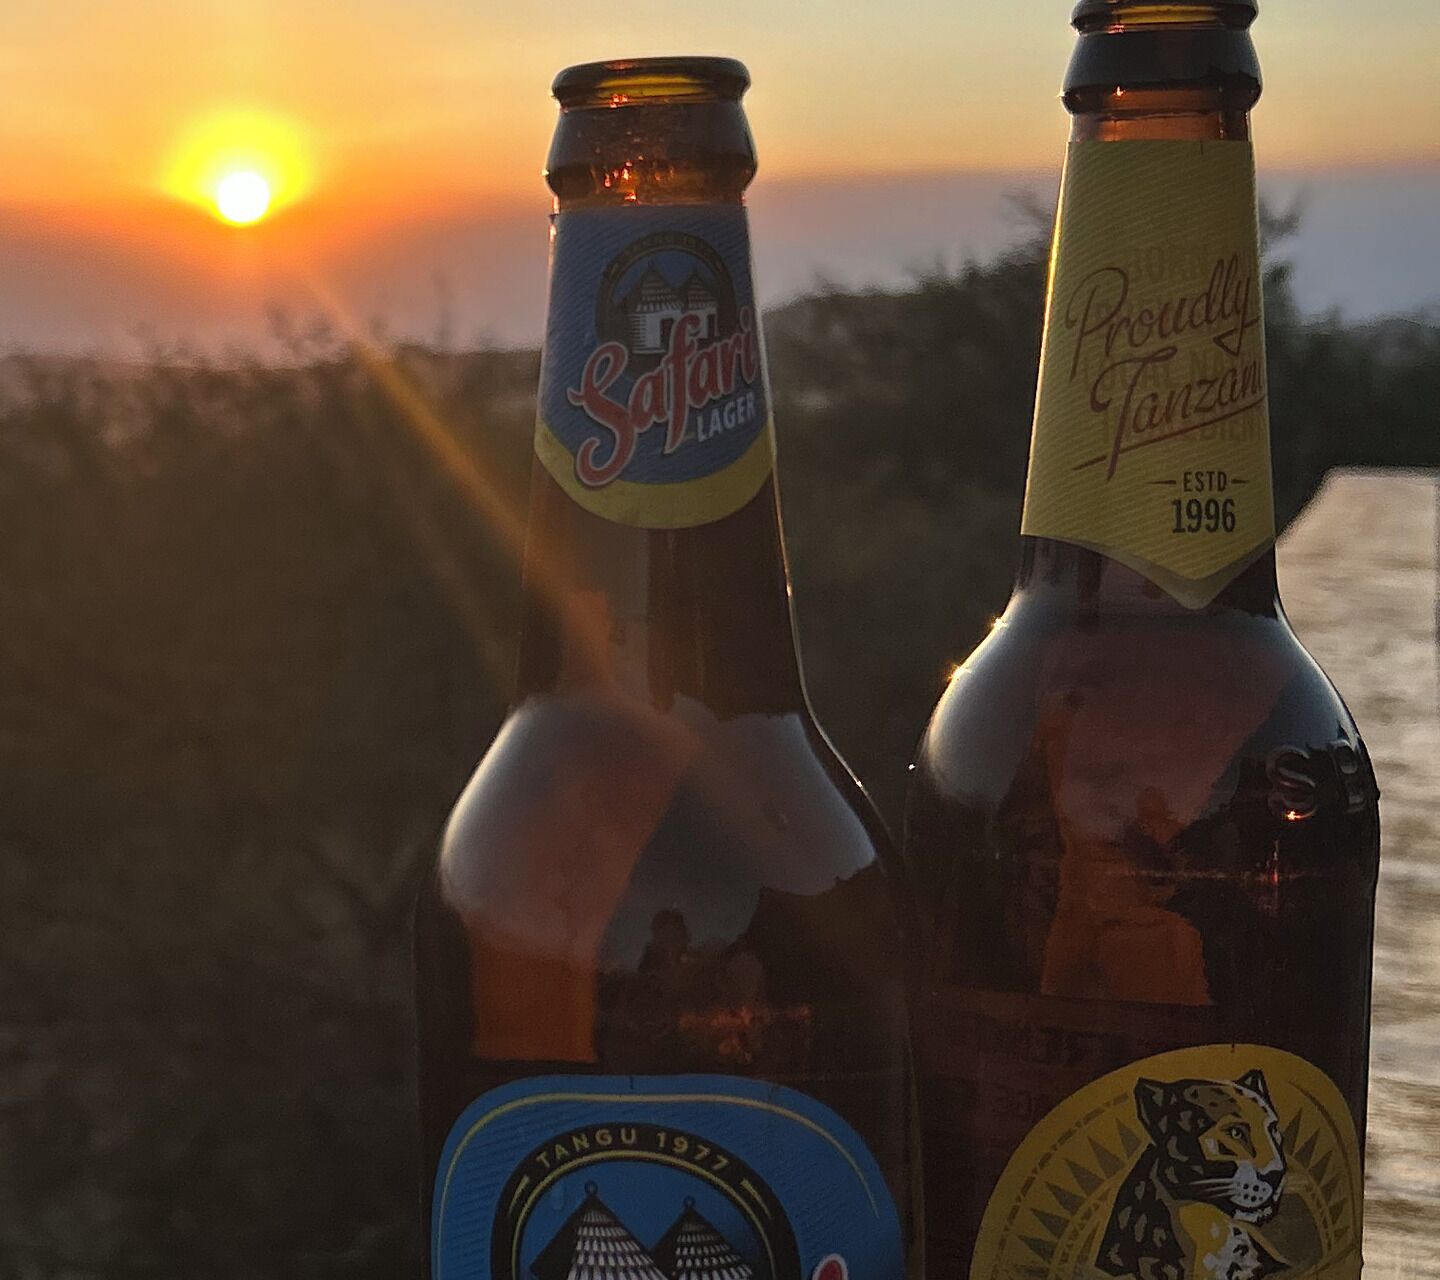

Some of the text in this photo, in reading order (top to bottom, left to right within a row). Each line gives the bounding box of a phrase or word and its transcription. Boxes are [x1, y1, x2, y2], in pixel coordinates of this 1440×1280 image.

[1065, 252, 1259, 382] Proudly
[567, 306, 756, 487] Safari
[696, 392, 756, 443] LAGER
[1182, 470, 1228, 492] ESTD
[1171, 498, 1237, 534] 1996
[535, 1127, 730, 1172] TANGU 1977
